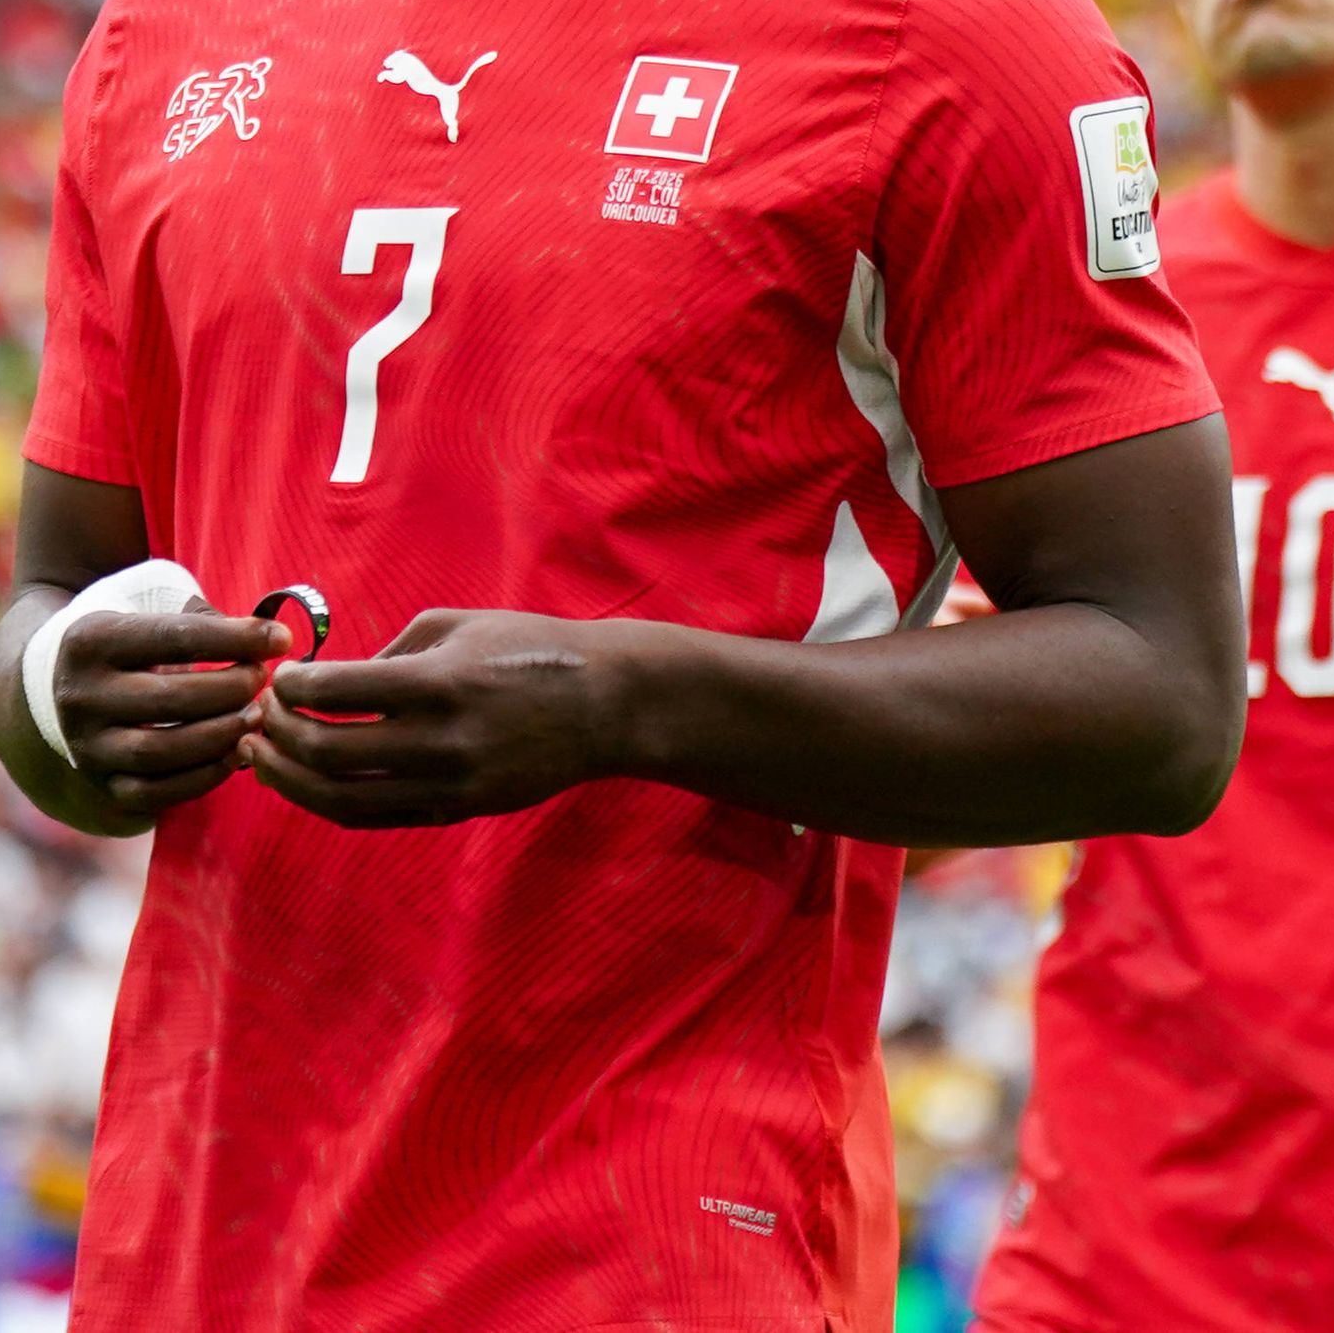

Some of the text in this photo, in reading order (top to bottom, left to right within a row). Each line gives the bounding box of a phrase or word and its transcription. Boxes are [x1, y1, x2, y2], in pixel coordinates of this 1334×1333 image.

[615, 168, 684, 186] 07.07.2026
[606, 182, 636, 202] SUI
[649, 185, 680, 206] COL
[602, 203, 677, 224] VANCOUVER
[329, 206, 461, 484] 7
[699, 1196, 777, 1227] ULTRAWEAVE
